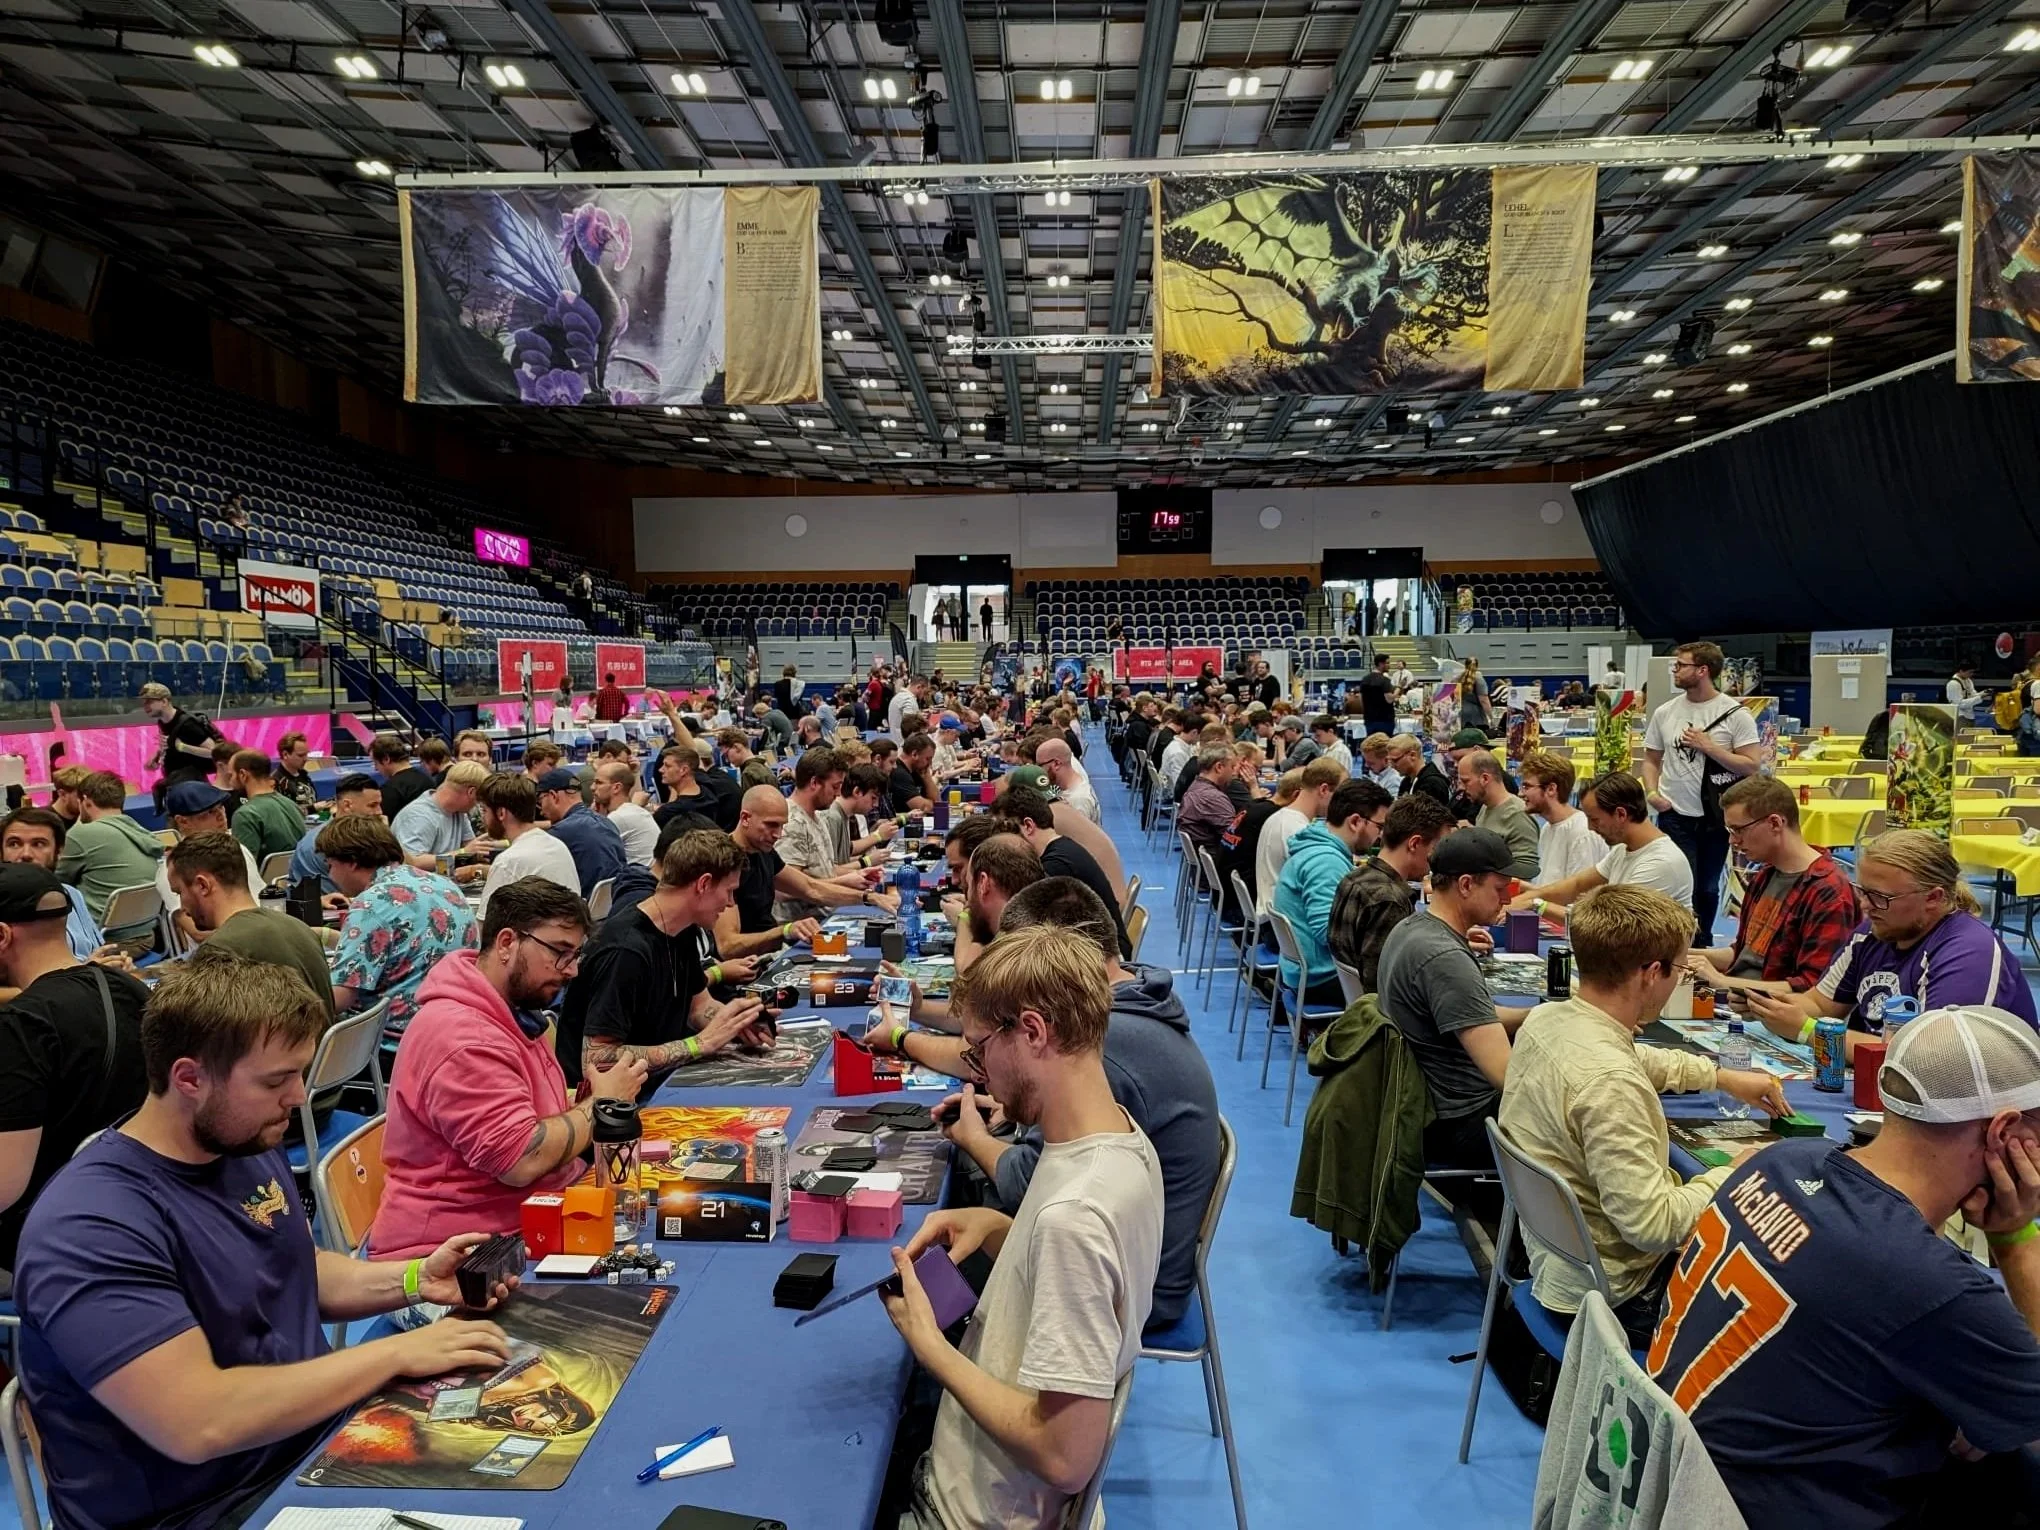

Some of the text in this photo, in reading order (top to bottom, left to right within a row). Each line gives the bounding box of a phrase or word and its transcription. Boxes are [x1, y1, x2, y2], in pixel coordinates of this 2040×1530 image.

[1504, 203, 1528, 212] LEHEL
[736, 222, 759, 230] EMME
[249, 583, 303, 607] MALMÖ
[834, 983, 855, 994] 23
[701, 1200, 726, 1218] 21
[1729, 1169, 1813, 1264] McDAVID
[1645, 1201, 1798, 1418] 97
